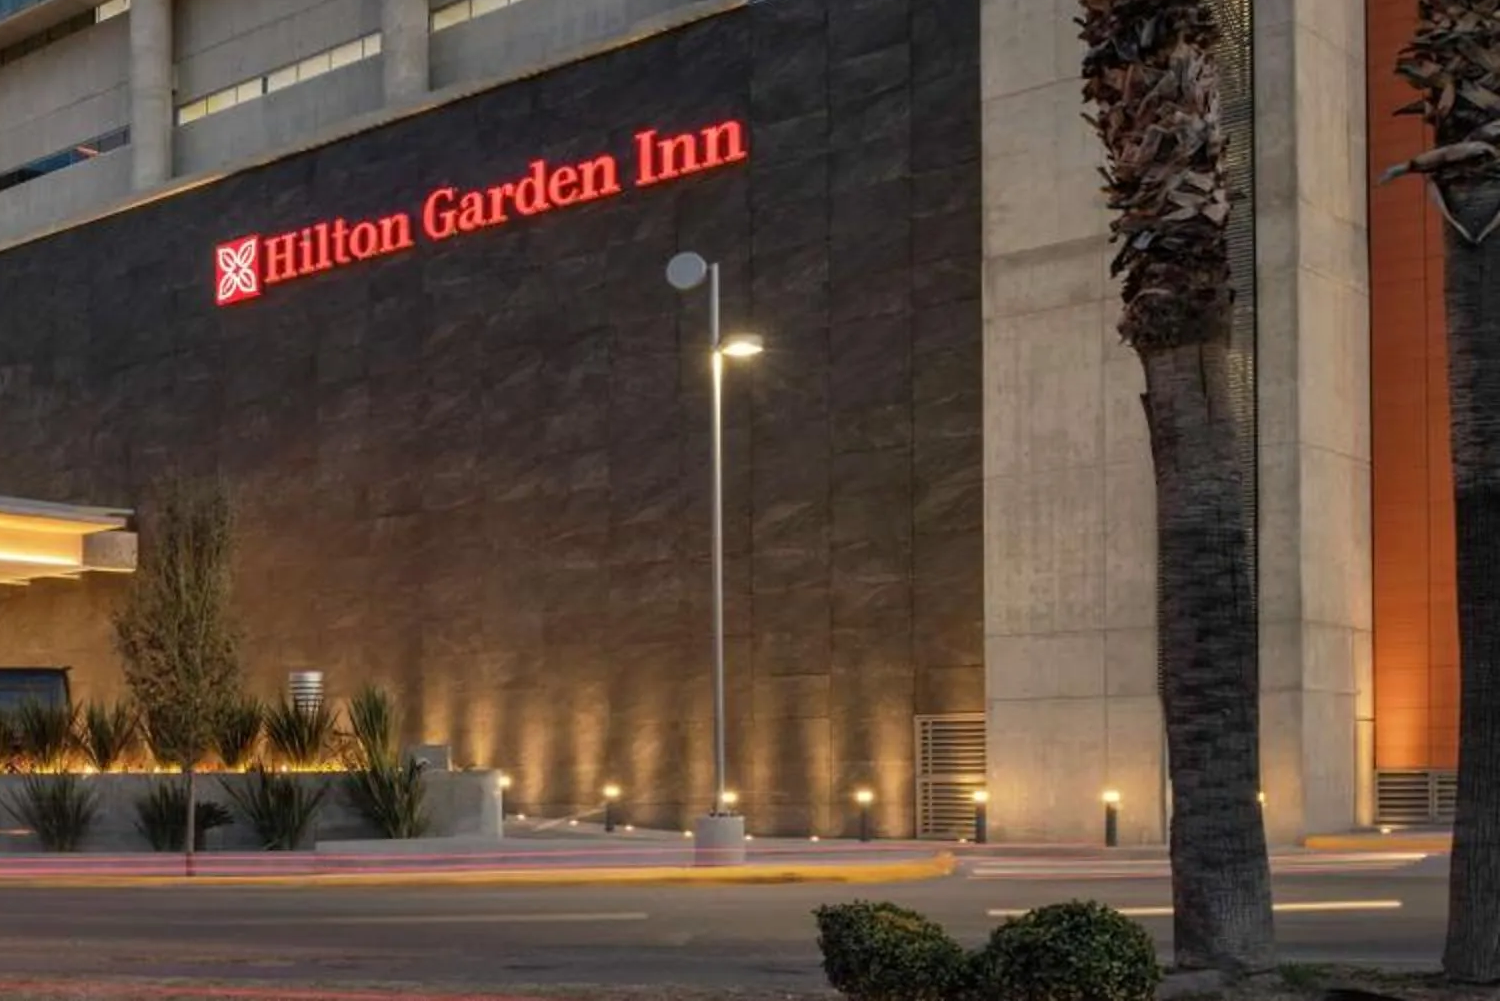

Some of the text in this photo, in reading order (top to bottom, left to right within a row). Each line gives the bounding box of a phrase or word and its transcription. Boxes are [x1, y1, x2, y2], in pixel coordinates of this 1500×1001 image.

[263, 120, 746, 284] Hilton Garden Inn
